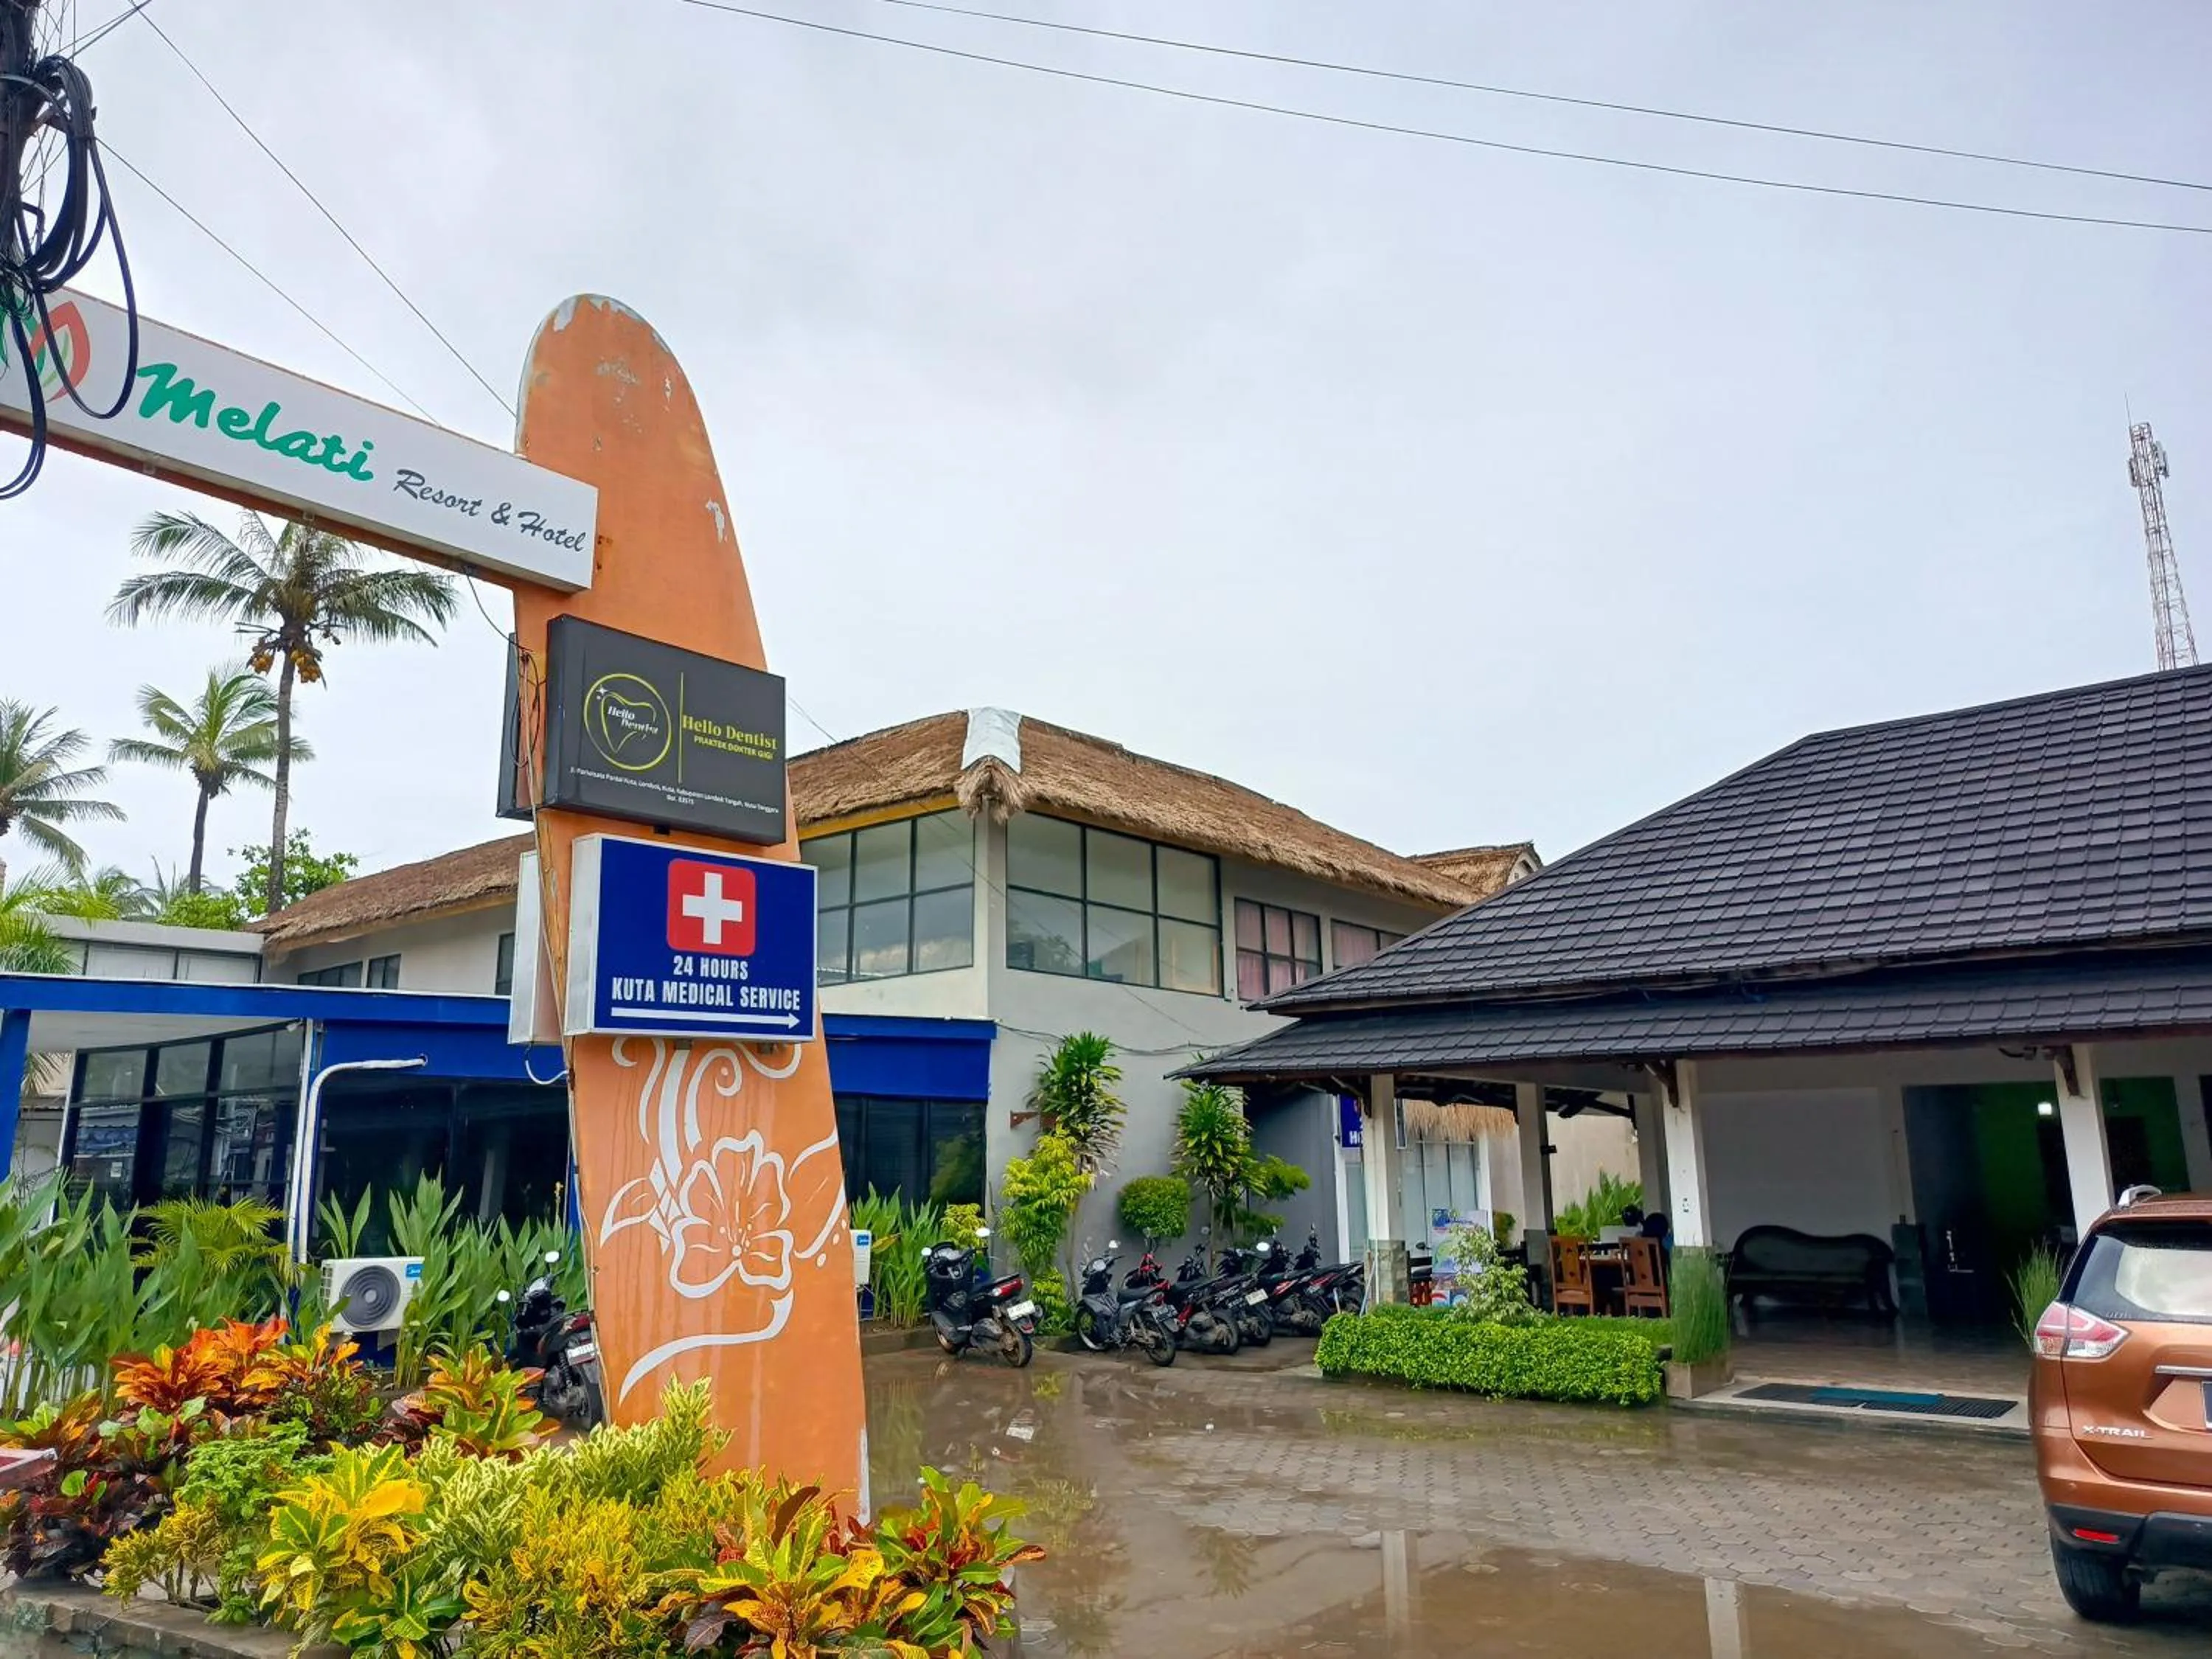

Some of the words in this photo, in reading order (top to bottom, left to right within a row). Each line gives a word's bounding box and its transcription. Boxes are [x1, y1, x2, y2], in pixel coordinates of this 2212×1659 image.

[136, 362, 376, 481] Melati
[394, 469, 483, 518] Resort
[491, 502, 512, 526] &
[517, 512, 587, 553] Hotel
[682, 714, 722, 737] Hello
[726, 725, 778, 750] Dentist
[694, 735, 727, 750] PRAKTEK
[728, 743, 757, 757] DOKTER
[673, 955, 694, 975] 24
[700, 957, 748, 981] HOURS
[611, 976, 655, 1002] KUTA
[661, 980, 734, 1007] MEDICAL
[740, 986, 801, 1011] SERVICE
